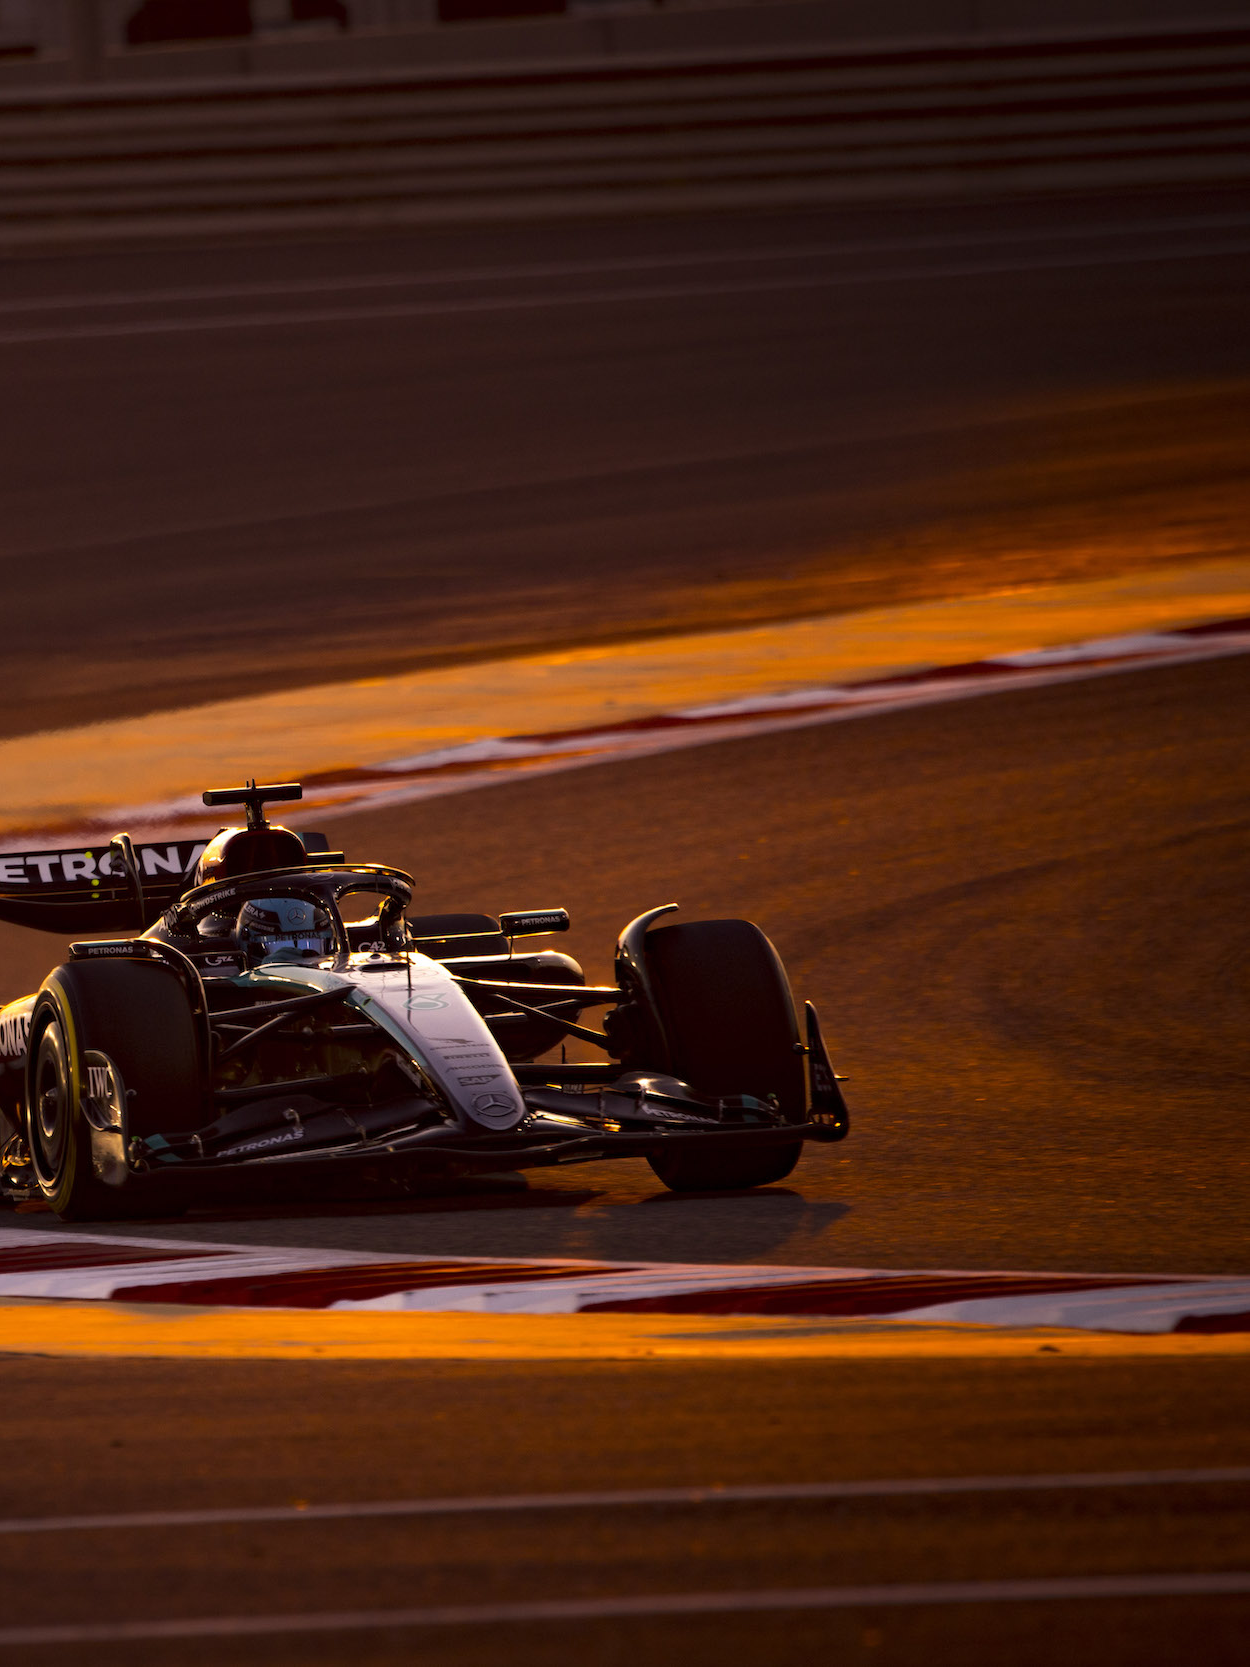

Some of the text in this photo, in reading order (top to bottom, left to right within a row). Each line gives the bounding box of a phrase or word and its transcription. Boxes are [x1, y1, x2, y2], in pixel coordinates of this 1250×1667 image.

[521, 915, 560, 926] PETRONAS
[276, 932, 321, 942] PETRONAS
[88, 946, 134, 956] PETRONAS
[87, 1066, 113, 1098] IWC
[459, 1075, 495, 1086] SAP
[215, 1129, 305, 1158] PETRONAS
